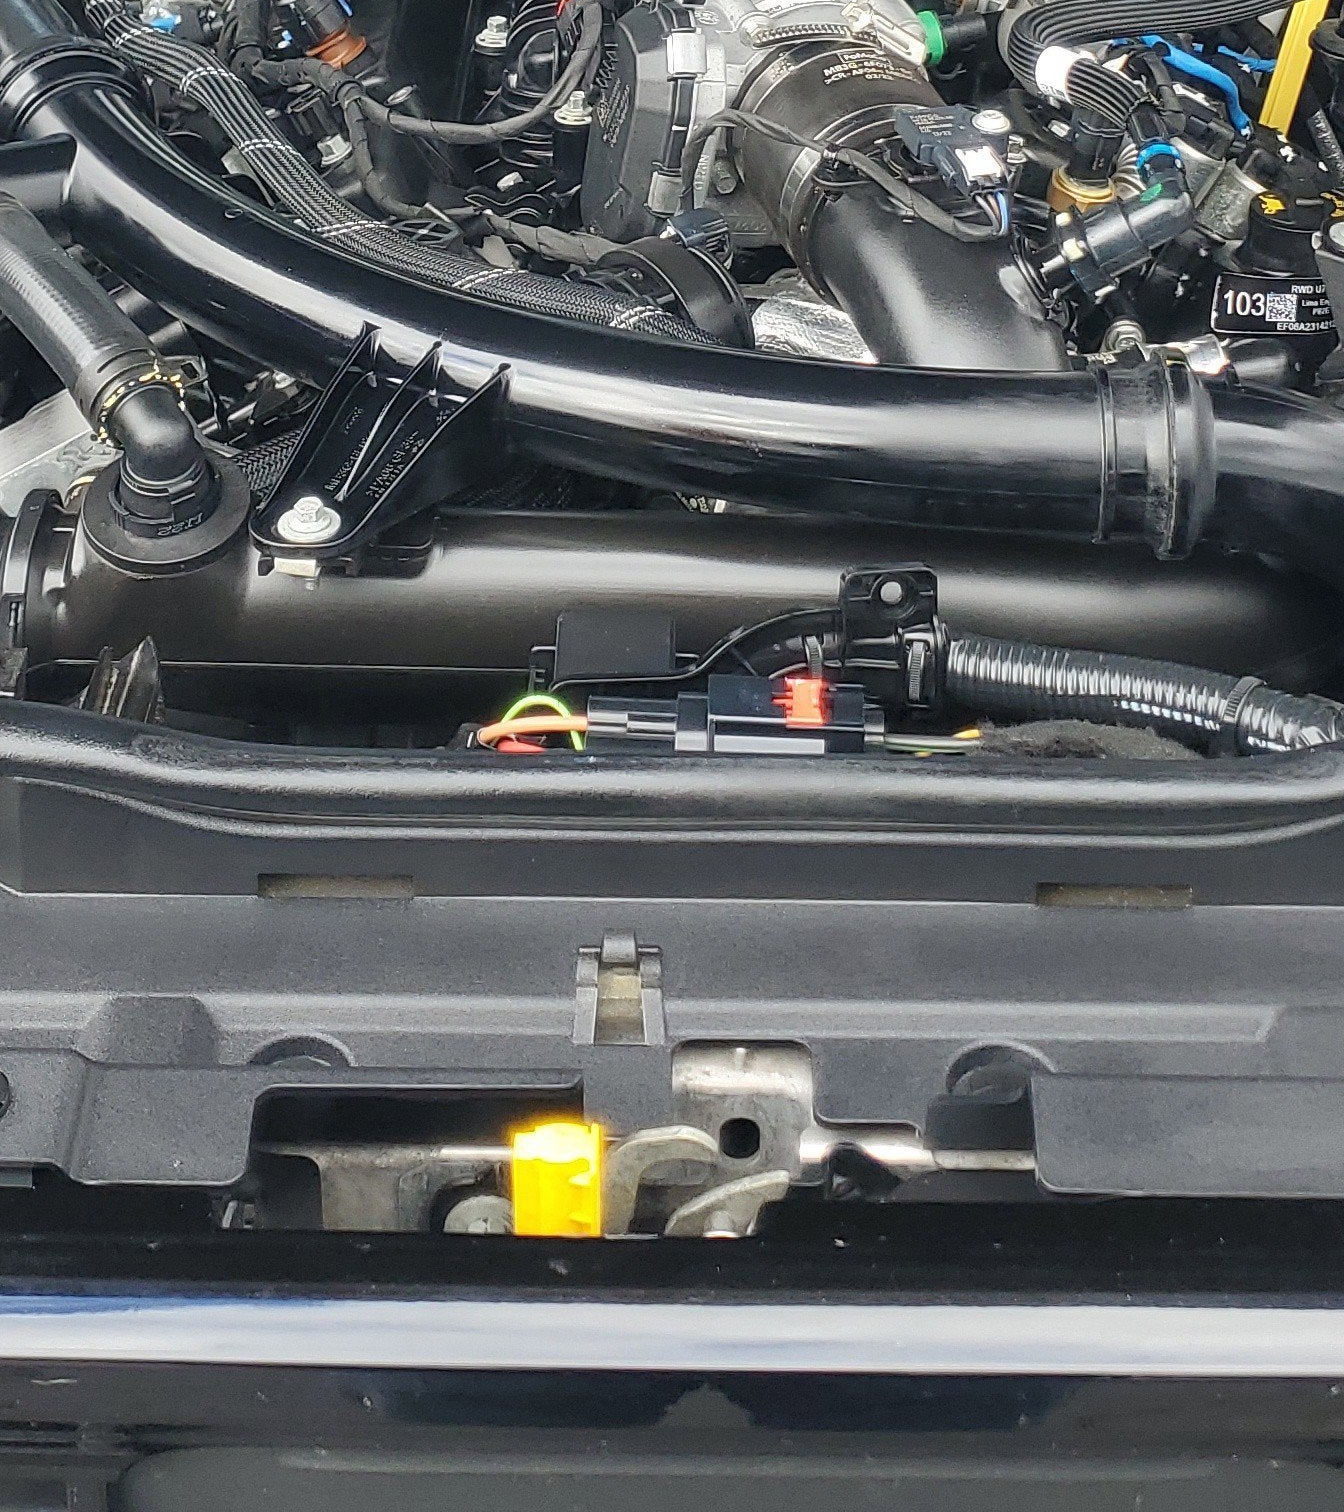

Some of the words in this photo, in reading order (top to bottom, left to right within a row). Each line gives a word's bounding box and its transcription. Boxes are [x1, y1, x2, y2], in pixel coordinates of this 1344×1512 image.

[1291, 284, 1313, 294] RWD
[1316, 284, 1326, 294] U7
[1223, 289, 1265, 316] 103
